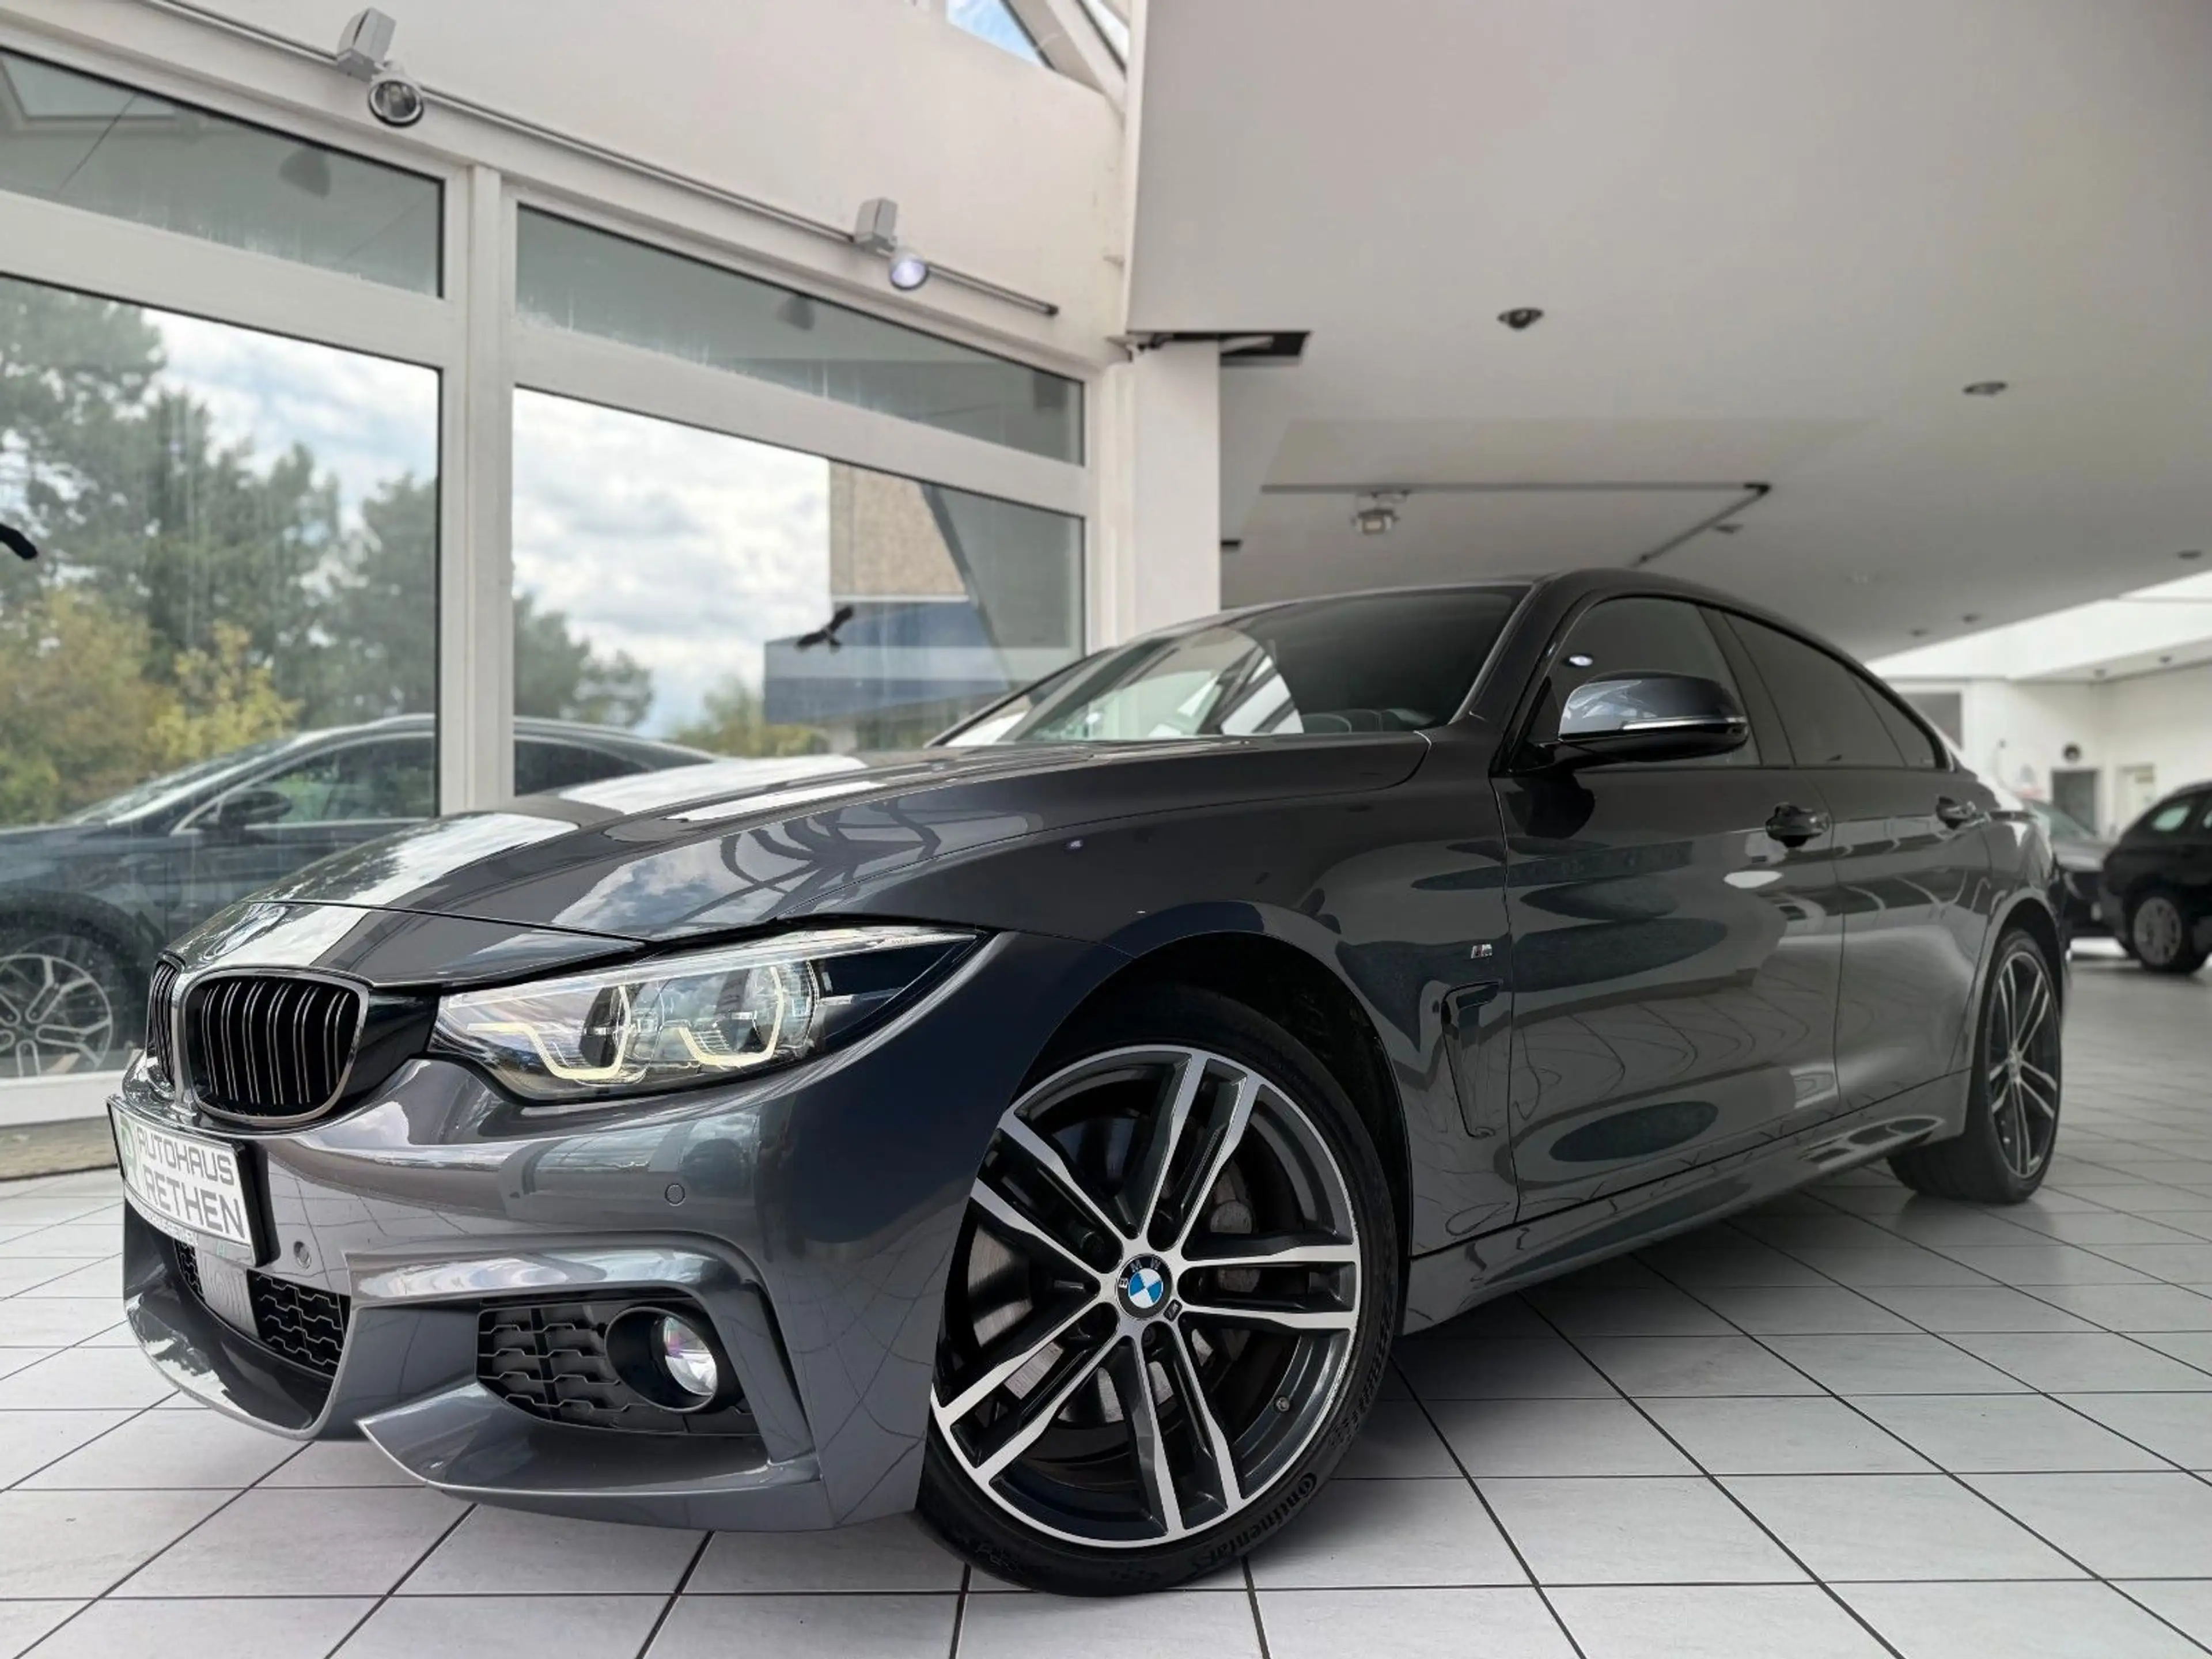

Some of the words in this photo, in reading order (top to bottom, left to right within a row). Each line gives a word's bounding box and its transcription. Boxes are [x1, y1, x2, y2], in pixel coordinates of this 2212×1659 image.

[137, 1126, 234, 1185] AUTOHAUS
[143, 1164, 245, 1238] RETHEN
[1119, 1258, 1162, 1289] BMW
